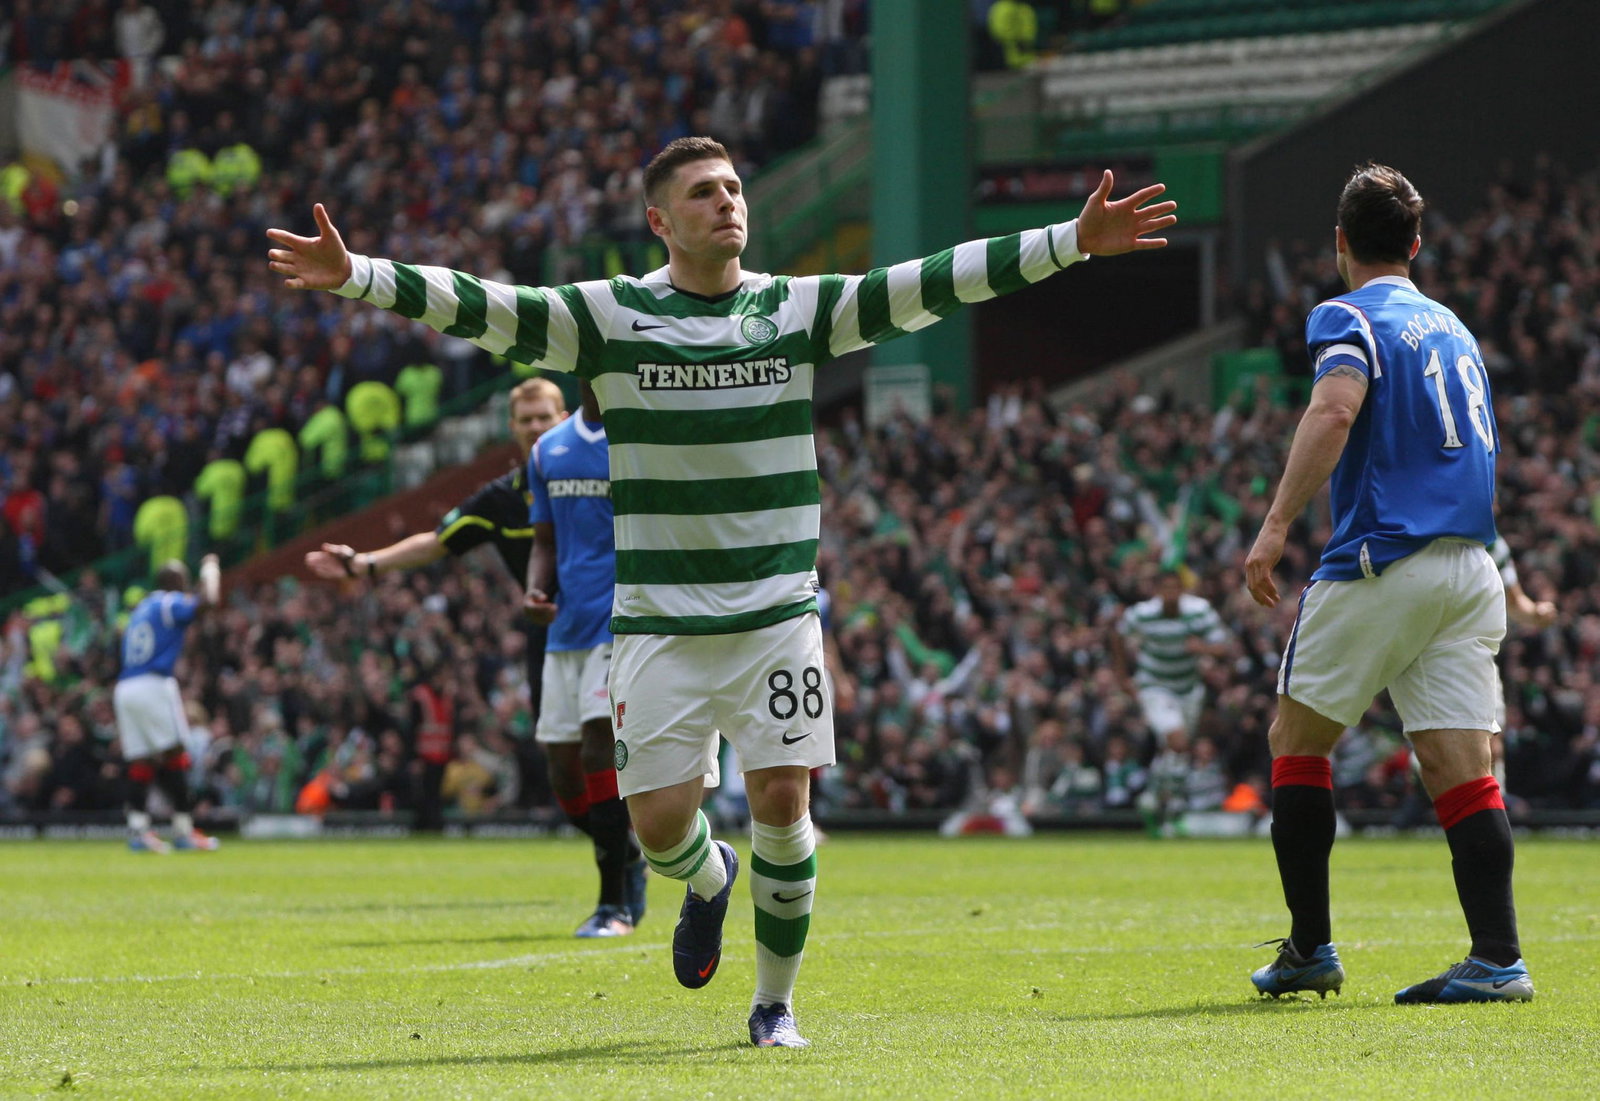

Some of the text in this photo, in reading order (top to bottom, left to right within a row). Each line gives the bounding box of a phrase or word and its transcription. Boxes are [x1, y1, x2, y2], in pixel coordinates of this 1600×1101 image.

[637, 357, 788, 388] TENNENT'S
[1424, 349, 1494, 452] 18
[547, 479, 611, 497] TENNEN
[768, 666, 824, 720] 88
